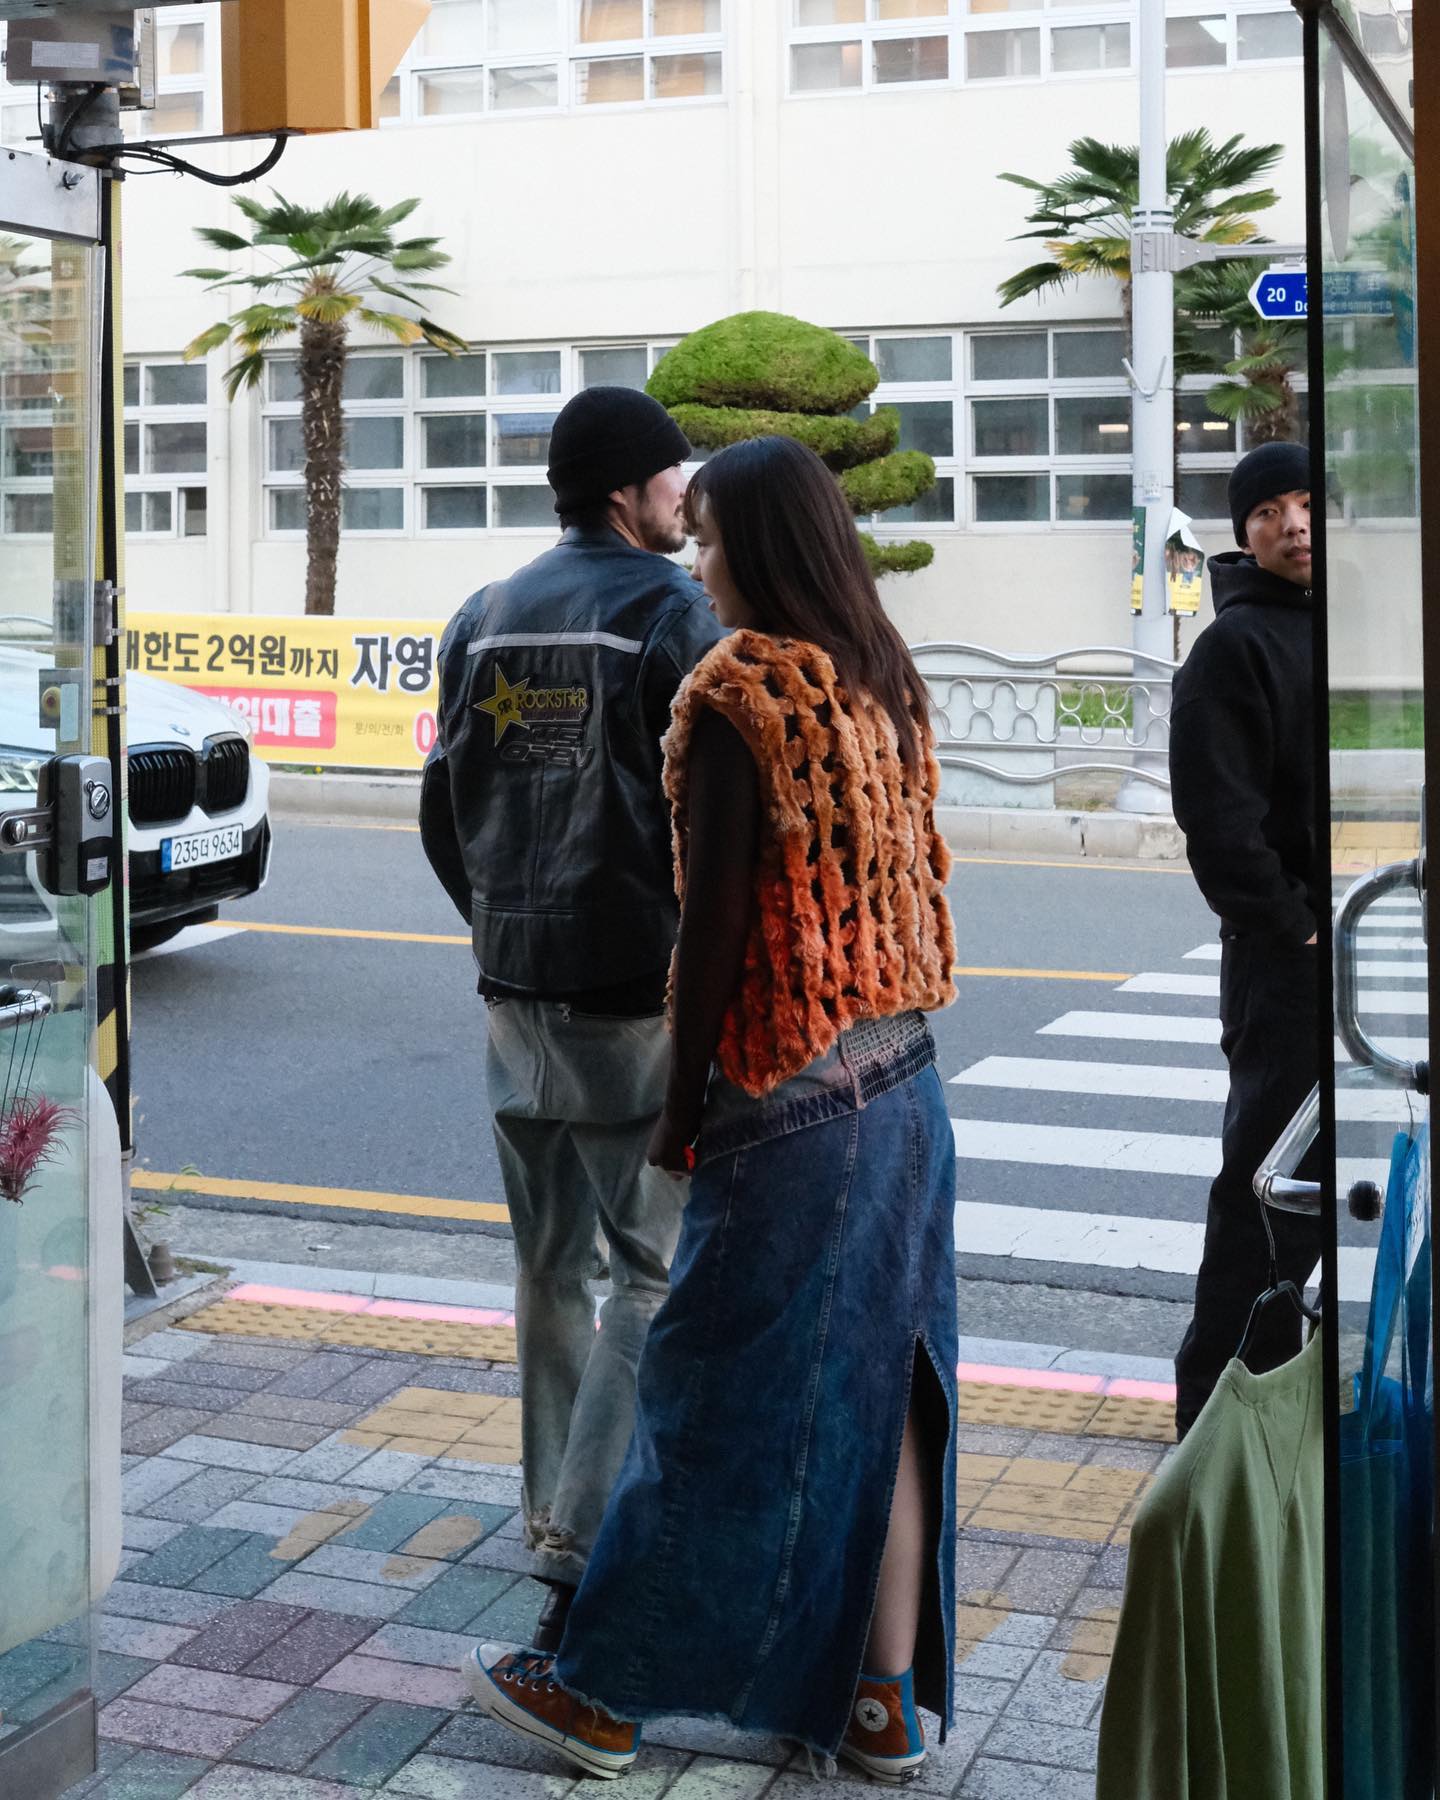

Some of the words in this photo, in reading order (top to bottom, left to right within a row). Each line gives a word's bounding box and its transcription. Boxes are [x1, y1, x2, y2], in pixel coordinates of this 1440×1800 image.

[1267, 287, 1286, 302] 20
[351, 636, 433, 692] 자영
[209, 696, 322, 738] 일대출
[212, 829, 240, 857] 9634
